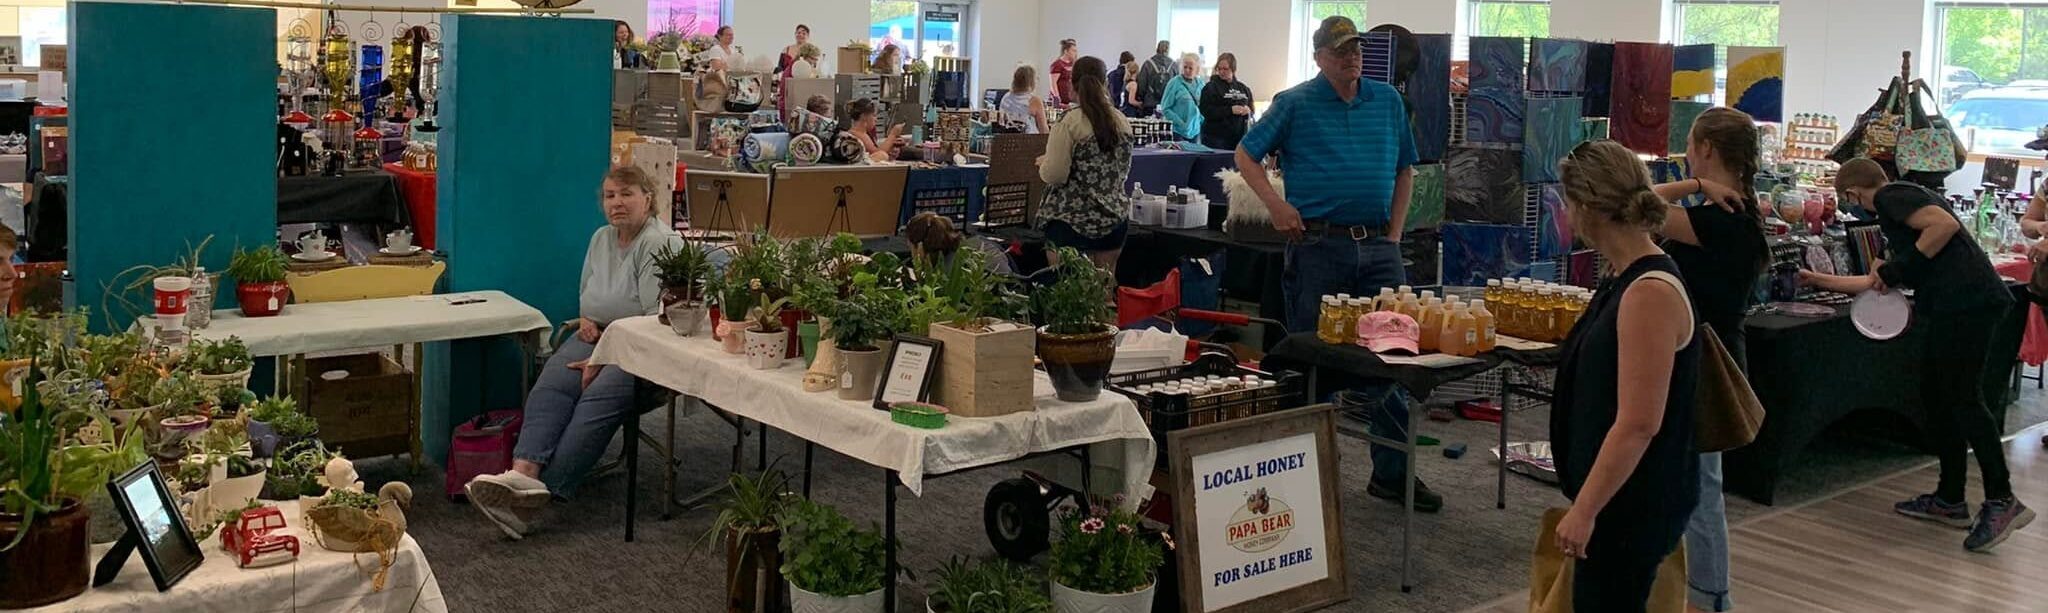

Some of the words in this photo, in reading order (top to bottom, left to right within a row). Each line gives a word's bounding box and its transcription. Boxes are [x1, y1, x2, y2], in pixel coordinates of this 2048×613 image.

[1203, 465, 1253, 490] LOCAL
[1256, 452, 1306, 477] HONEY
[1229, 522, 1257, 541] PAPA
[1262, 513, 1291, 533] BEAR
[1214, 567, 1240, 587] FOR
[1243, 557, 1276, 578] SALE
[1279, 547, 1313, 568] HERE
